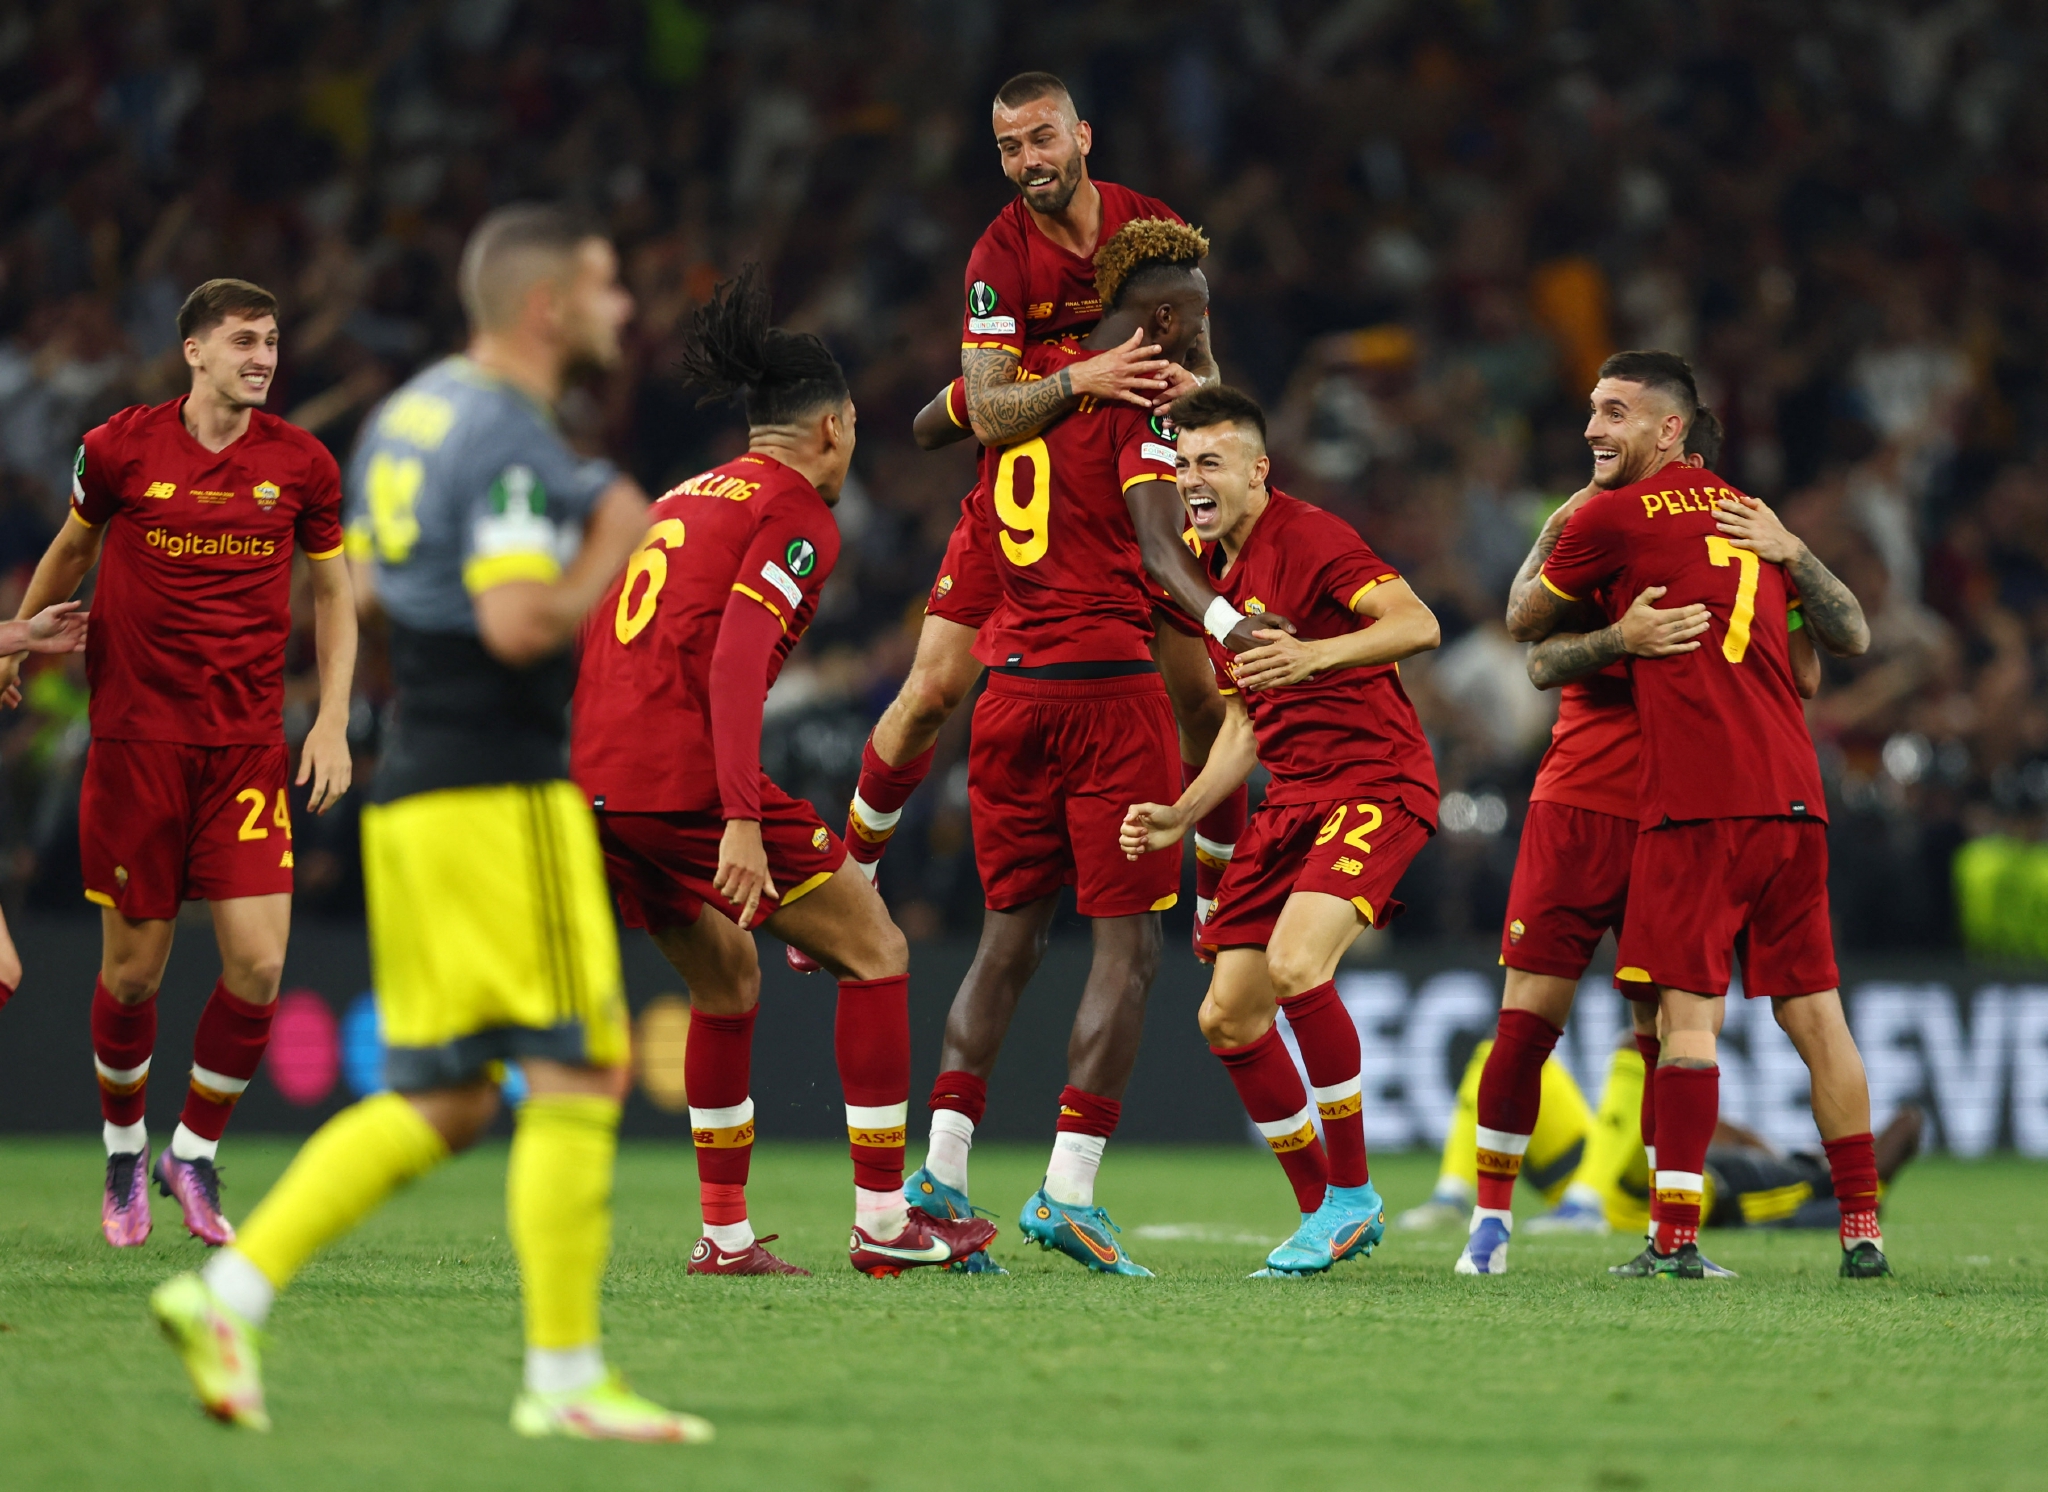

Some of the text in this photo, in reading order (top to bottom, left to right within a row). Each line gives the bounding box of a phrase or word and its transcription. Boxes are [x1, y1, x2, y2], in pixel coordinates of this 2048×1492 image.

[994, 436, 1050, 567] 9
[1640, 486, 1740, 519] PELLE
[145, 527, 275, 558] digitalbits
[614, 518, 686, 645] 6
[1704, 535, 1761, 664] 7
[235, 787, 292, 842] 24
[1315, 803, 1383, 854] 92
